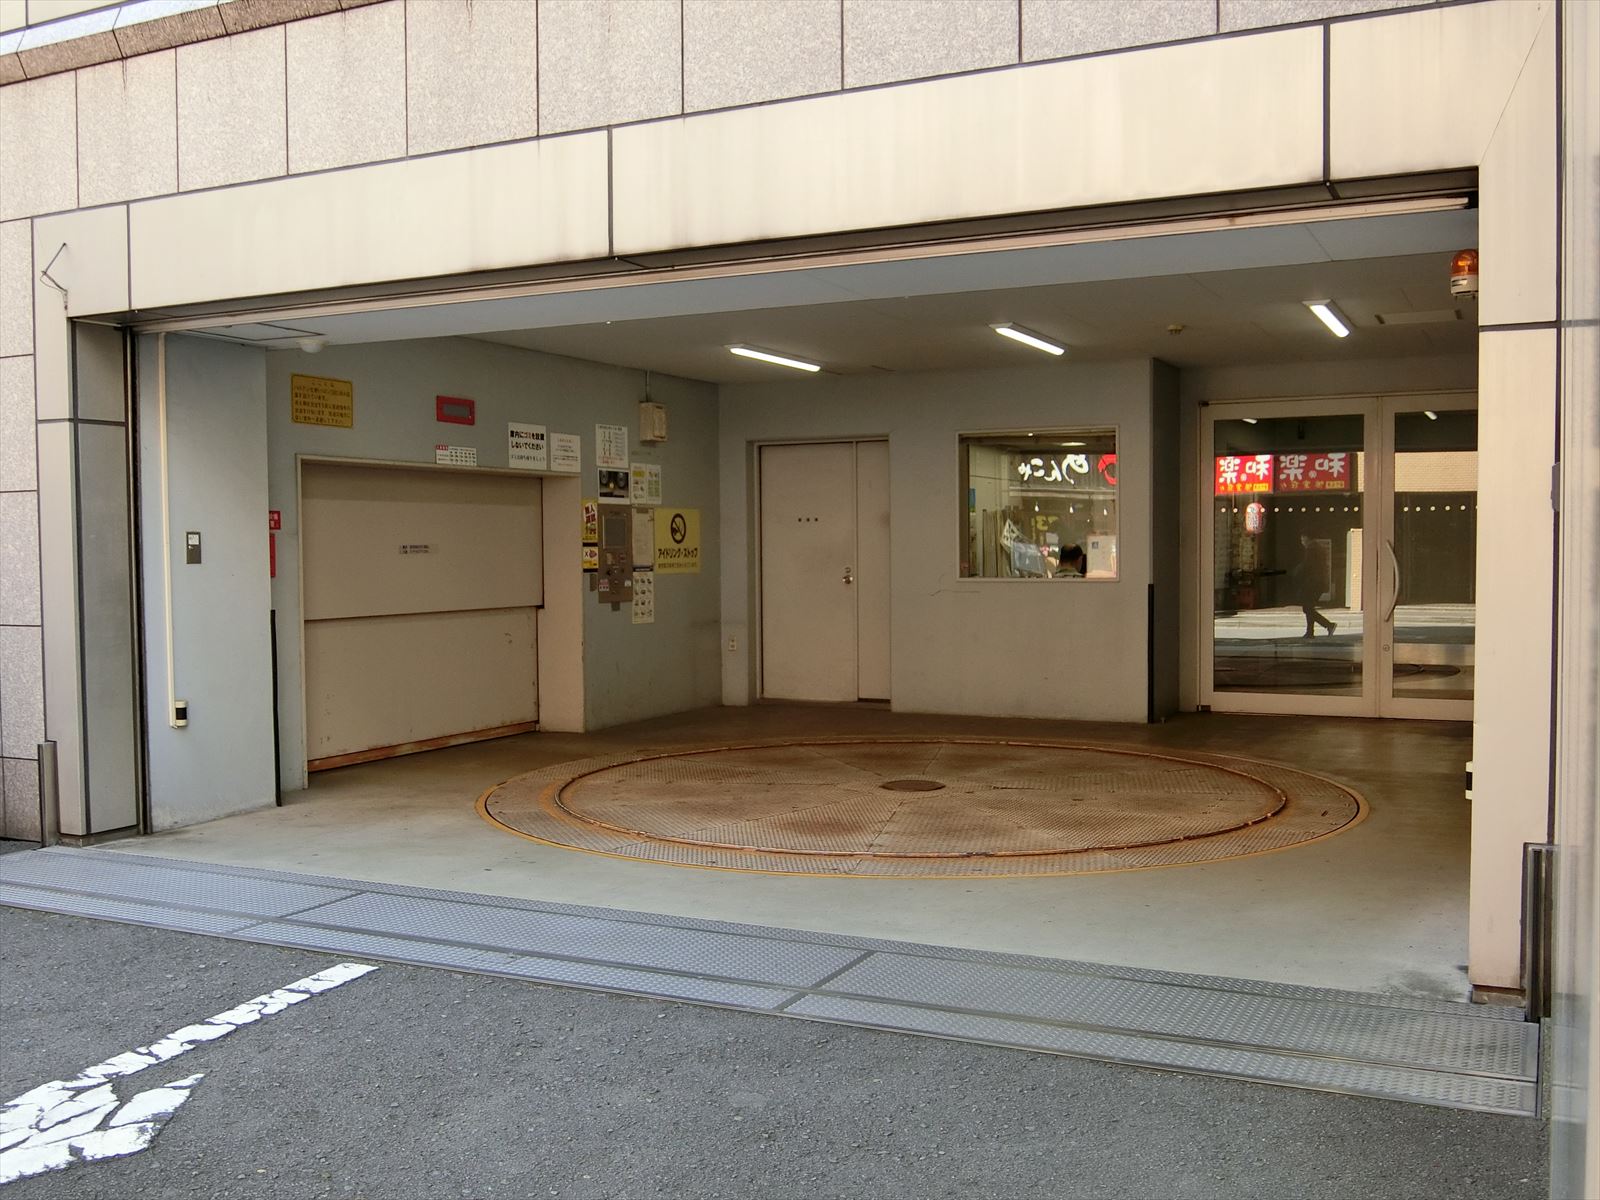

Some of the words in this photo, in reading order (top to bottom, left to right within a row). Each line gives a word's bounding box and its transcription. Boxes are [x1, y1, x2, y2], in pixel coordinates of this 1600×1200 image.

[511, 441, 544, 451] しないでください
[657, 547, 698, 559] アイドリング・ストップ
